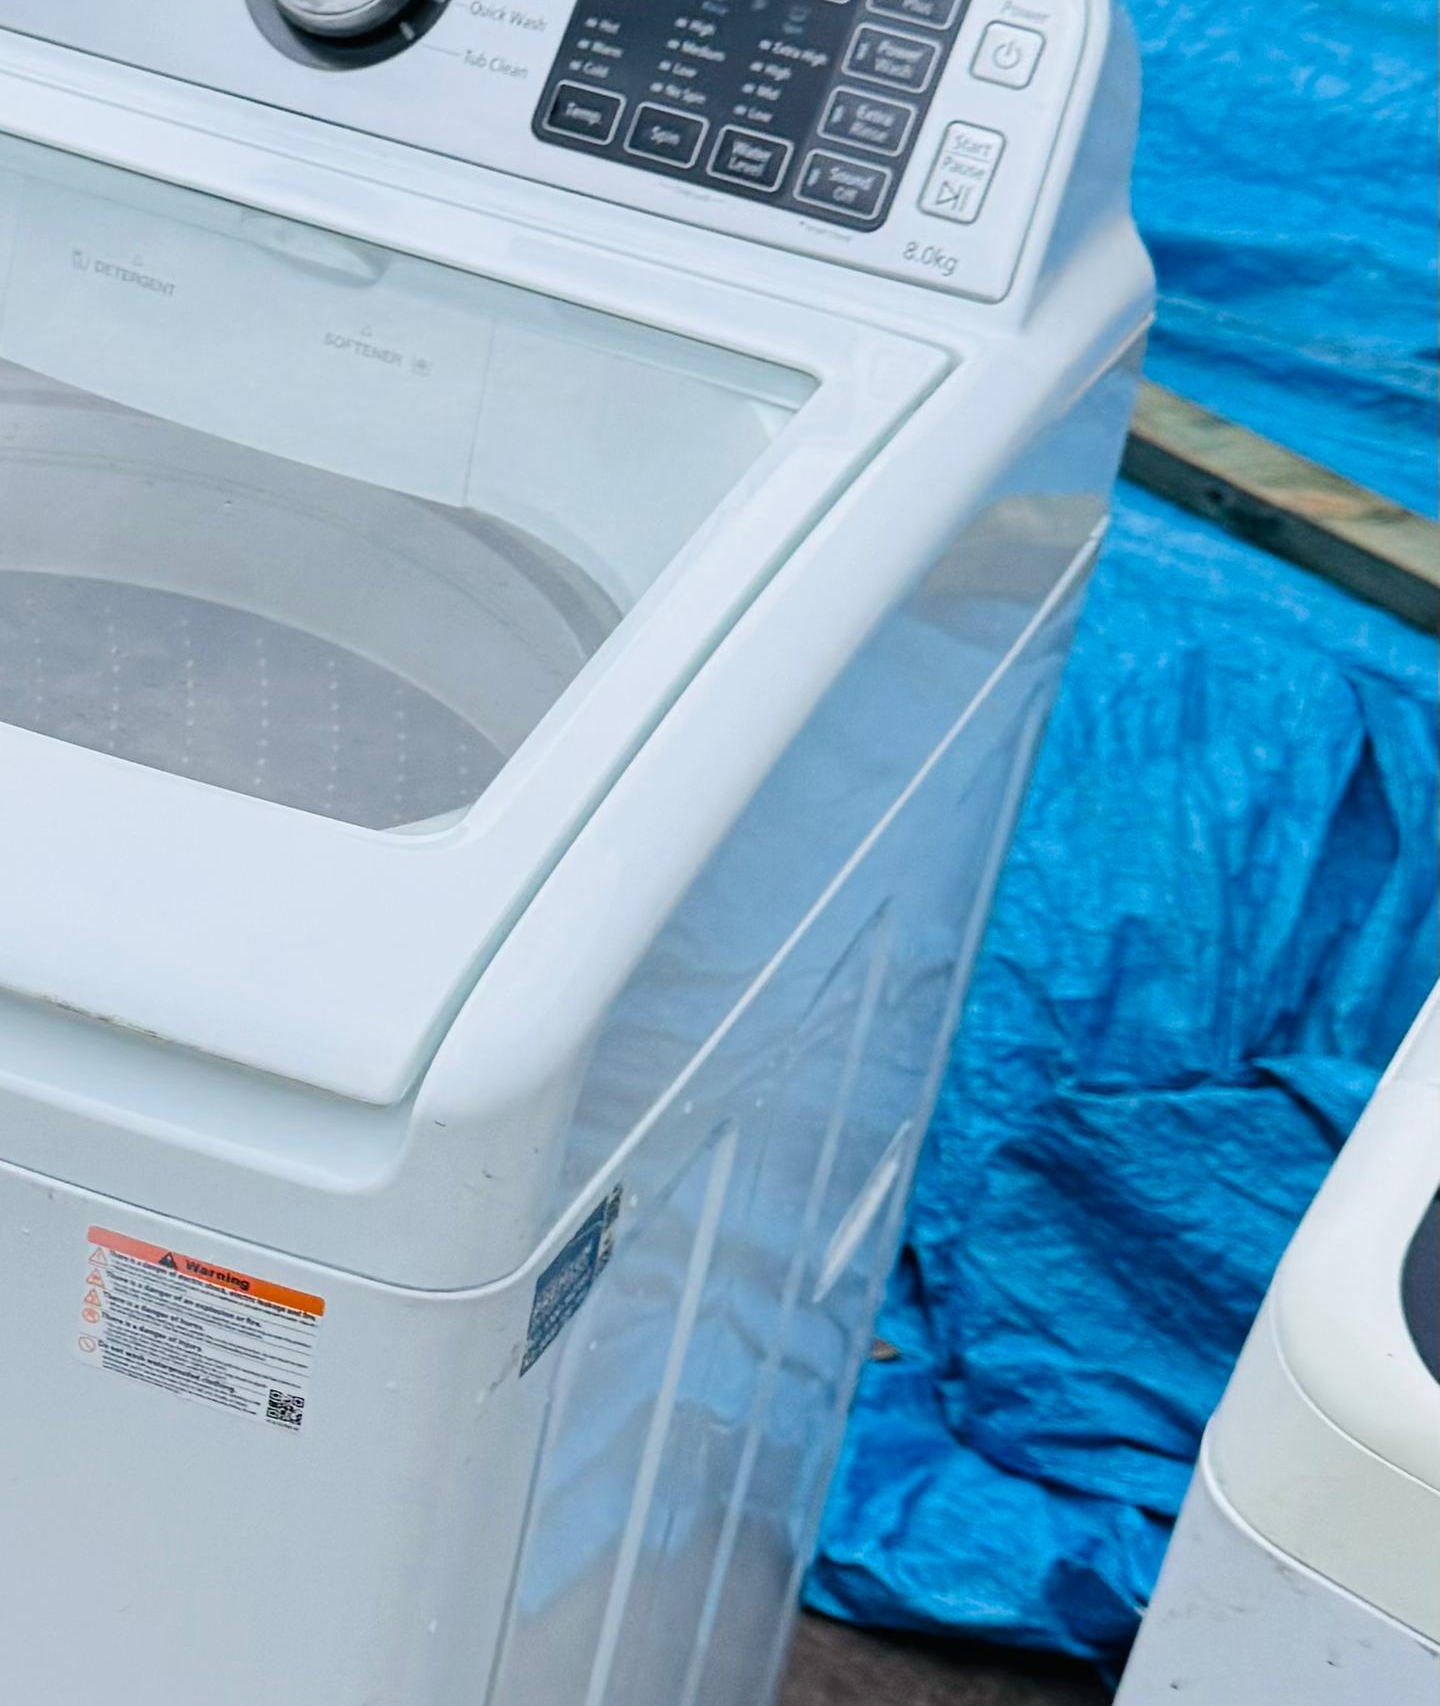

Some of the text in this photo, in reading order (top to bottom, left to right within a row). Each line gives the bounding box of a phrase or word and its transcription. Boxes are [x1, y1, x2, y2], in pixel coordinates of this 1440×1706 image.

[470, 0, 547, 32] Quick Wash
[1000, 0, 1051, 21] Power
[464, 49, 529, 79] Tub Clean
[582, 62, 609, 77] Cold
[856, 106, 895, 126] Extra
[650, 126, 682, 145] Spin
[954, 134, 993, 156] Start
[732, 142, 772, 161] Water
[828, 167, 875, 189] Sound
[942, 157, 986, 180] Pause
[832, 186, 857, 202] Off
[902, 241, 958, 276] 8.0kg
[94, 259, 176, 296] DETERGENT
[324, 331, 403, 368] SOFTENER
[185, 1259, 250, 1291] Warning
[102, 1290, 125, 1303] There
[140, 1305, 168, 1319] danger
[105, 1270, 128, 1283] There
[143, 1284, 171, 1299] danger
[194, 1301, 234, 1319] explosion
[100, 1311, 124, 1324] There
[139, 1325, 167, 1340] danger
